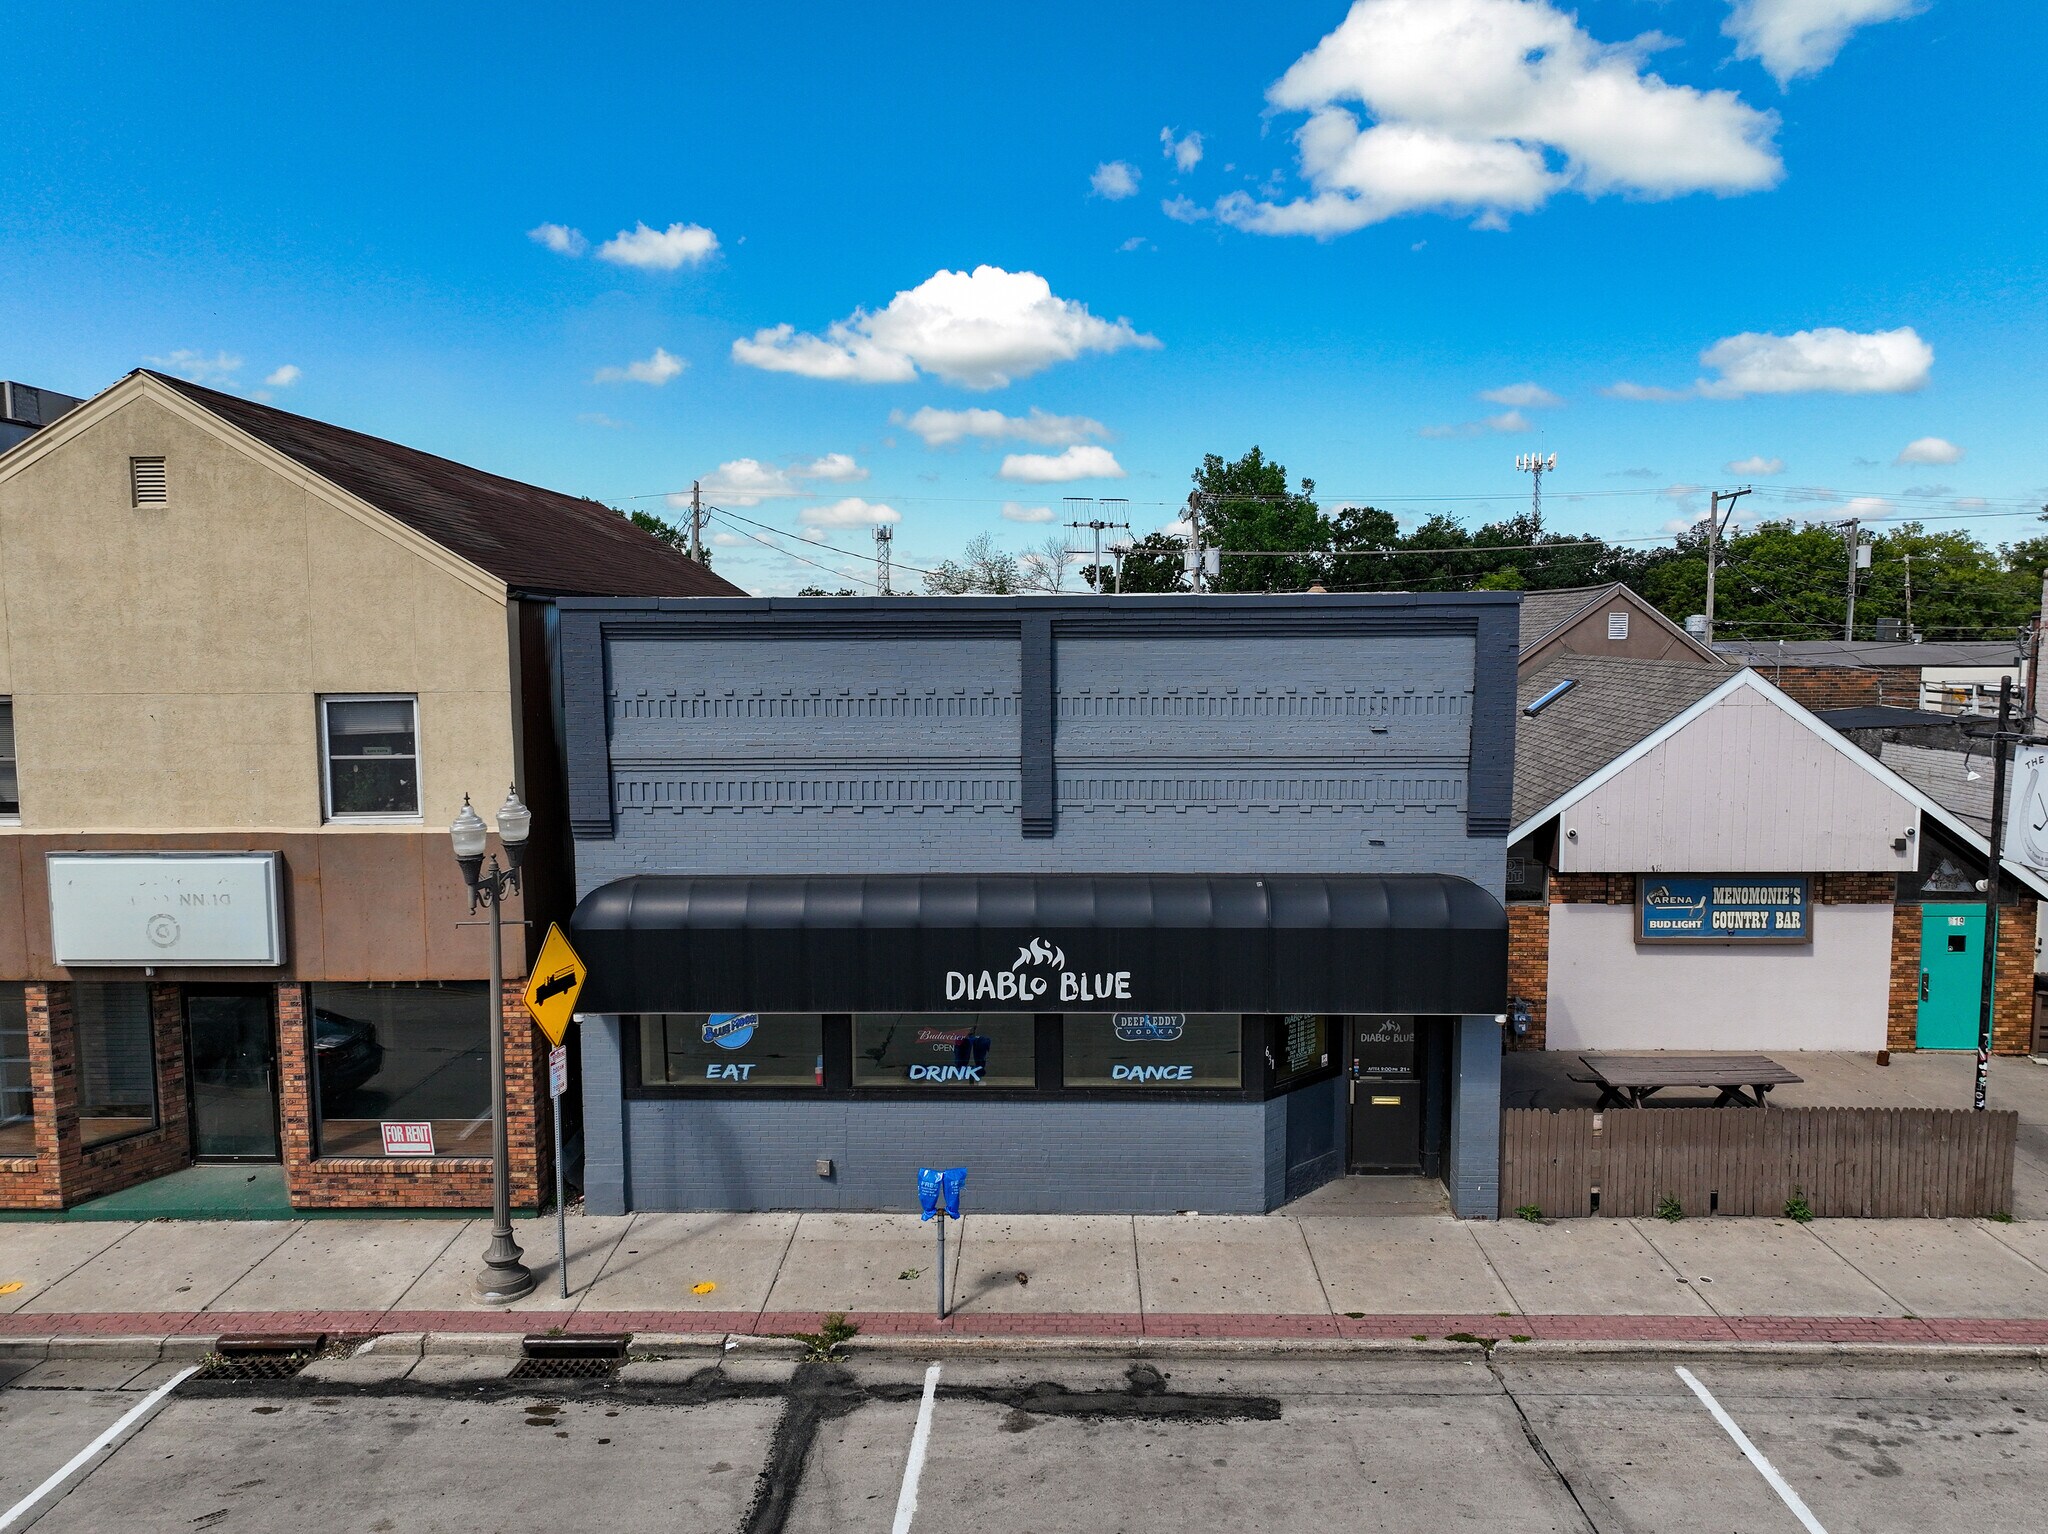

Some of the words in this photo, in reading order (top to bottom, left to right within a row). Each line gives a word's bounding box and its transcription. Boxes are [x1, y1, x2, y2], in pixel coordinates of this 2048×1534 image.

[2025, 756, 2045, 769] THE
[1653, 896, 1693, 904] ARENA
[1712, 887, 1801, 905] MENOMONIE'S
[1650, 920, 1671, 929] BUD
[1672, 920, 1703, 929] LIGHT
[1712, 911, 1769, 929] COUNTRY
[1775, 911, 1801, 929] BAR
[945, 970, 1047, 1001] DIABLO
[1060, 971, 1132, 1001] BLUE
[1121, 1016, 1145, 1027] DEEP
[1152, 1016, 1177, 1026] EDDY
[918, 1030, 966, 1041] Budweiser
[1360, 1033, 1390, 1042] DIABLO
[1393, 1033, 1415, 1043] BLUE
[933, 1043, 955, 1052] OPEN
[1265, 1045, 1275, 1070] 631
[706, 1064, 756, 1081] EAT
[909, 1064, 983, 1083] DRINK
[1112, 1064, 1193, 1083] DANCE
[385, 1125, 404, 1142] FOR
[405, 1125, 429, 1142] RENT
